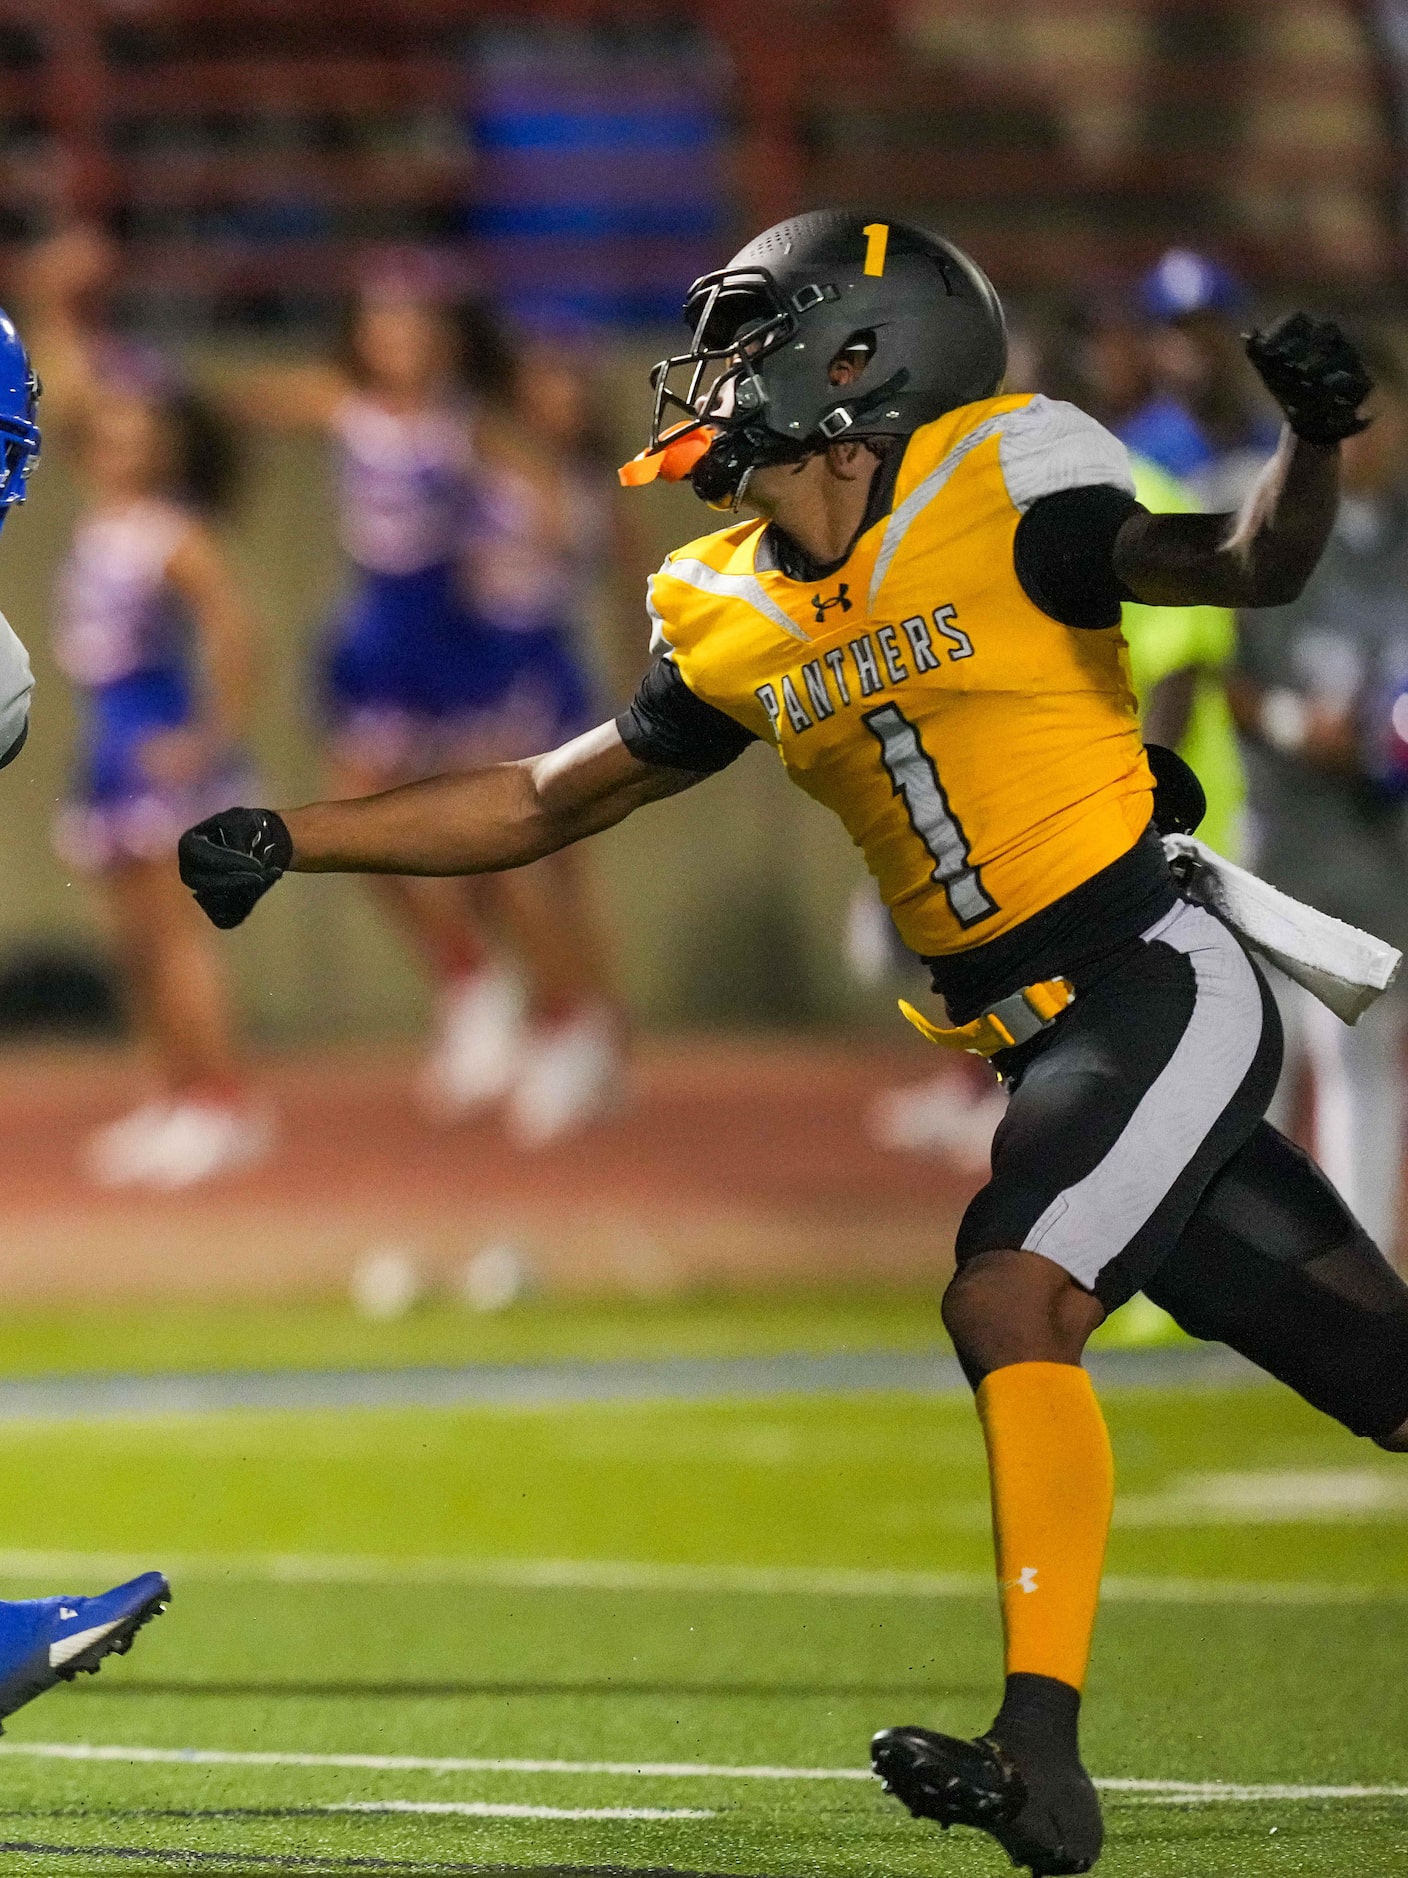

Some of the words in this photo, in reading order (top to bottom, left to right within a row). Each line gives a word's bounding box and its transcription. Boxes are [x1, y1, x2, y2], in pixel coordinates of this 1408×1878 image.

[863, 223, 889, 277] 1
[755, 603, 974, 742] PANTHERS
[860, 701, 1002, 930] 1
